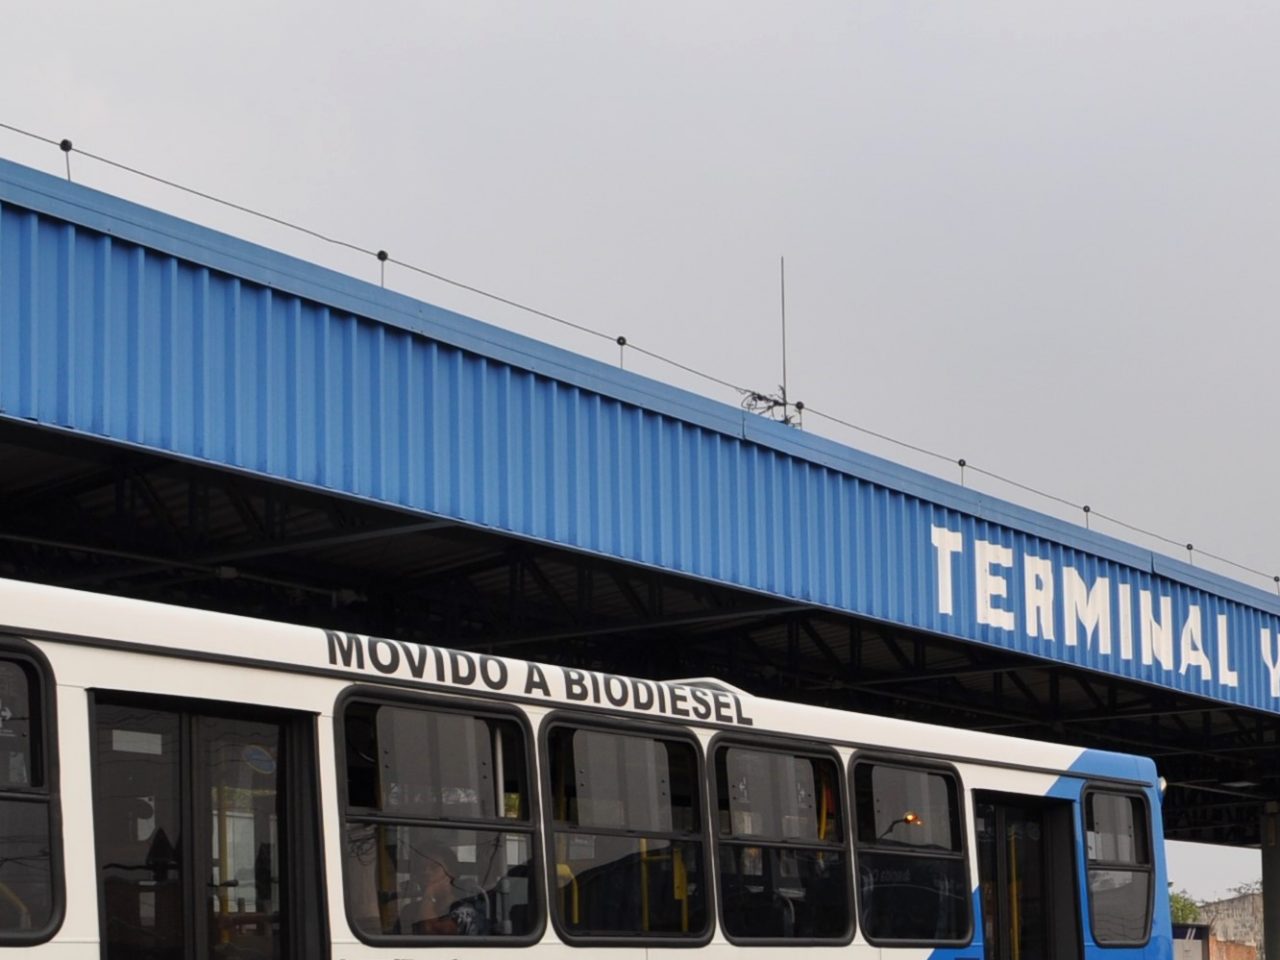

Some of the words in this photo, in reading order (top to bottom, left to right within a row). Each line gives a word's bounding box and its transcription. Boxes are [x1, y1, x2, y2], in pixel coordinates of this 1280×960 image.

[931, 523, 1238, 687] TERMINAL
[324, 630, 508, 690] MOVIDO
[523, 661, 551, 698] A
[561, 668, 754, 726] BIODIESEL
